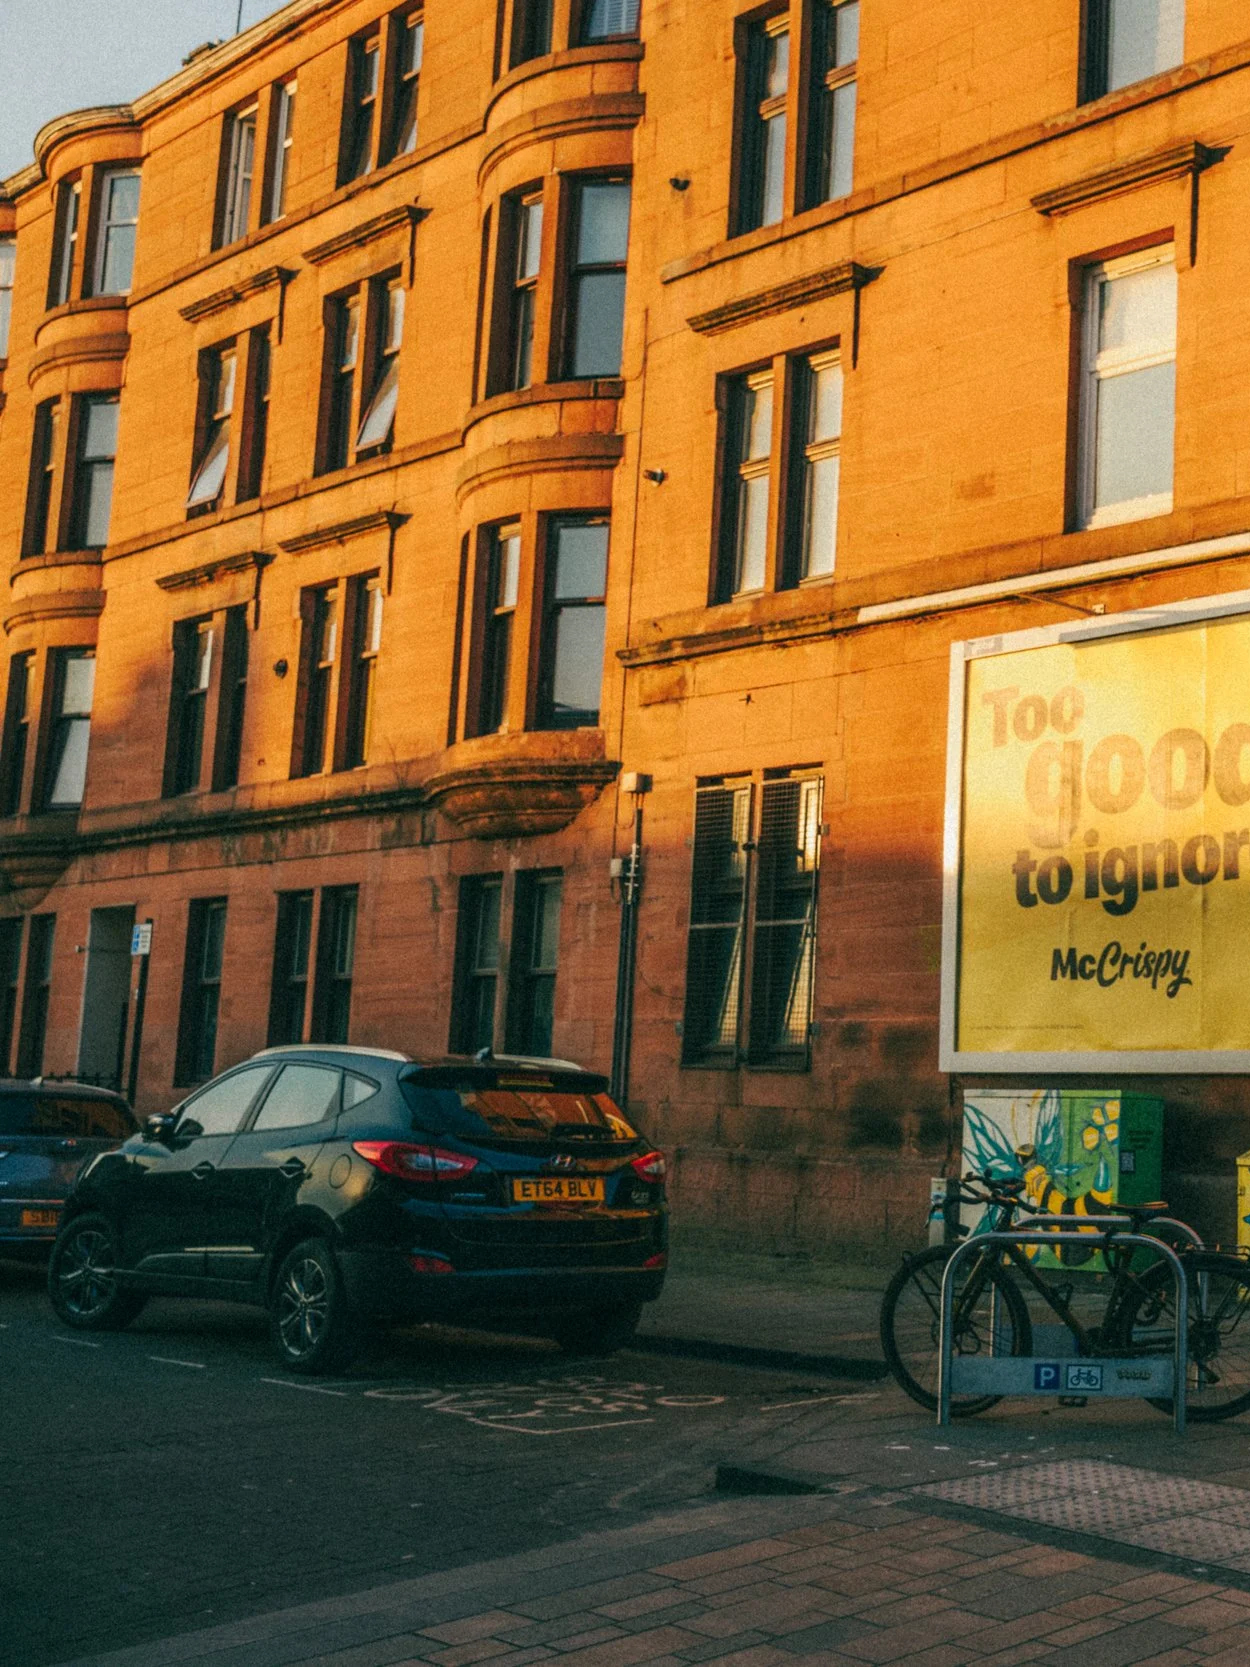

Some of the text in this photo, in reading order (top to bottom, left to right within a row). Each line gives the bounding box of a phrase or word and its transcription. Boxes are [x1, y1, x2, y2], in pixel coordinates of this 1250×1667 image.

[981, 685, 1085, 748] Too
[1011, 849, 1074, 909] to
[1050, 941, 1193, 999] McCrispy
[521, 1180, 597, 1198] ET64 BLV
